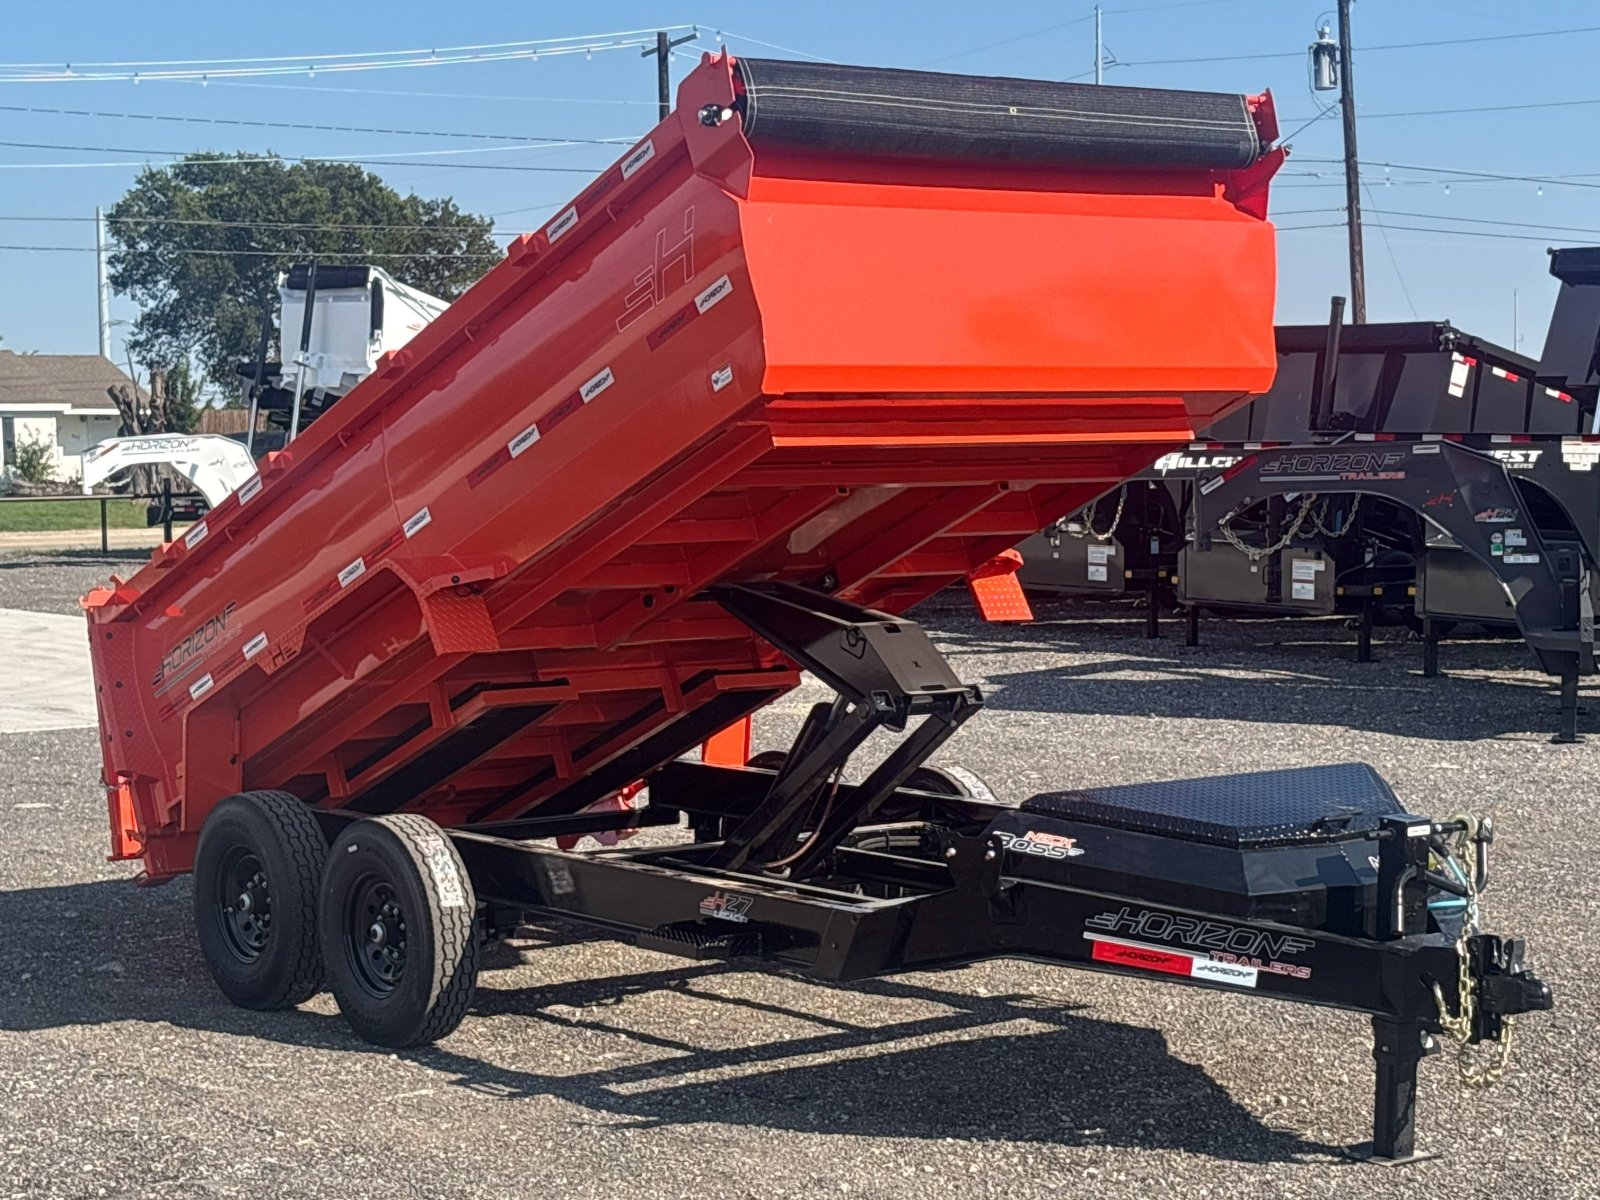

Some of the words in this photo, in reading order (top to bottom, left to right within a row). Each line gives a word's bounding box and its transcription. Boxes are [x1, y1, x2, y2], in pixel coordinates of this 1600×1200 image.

[123, 439, 198, 451] HORIZON
[1260, 453, 1404, 473] HORIZON
[1339, 471, 1406, 481] TRAILERS
[152, 601, 236, 686] HORIZON
[1085, 907, 1315, 959] HORIZON
[1196, 964, 1255, 979] HORIZON
[1210, 950, 1312, 979] TRAILERS
